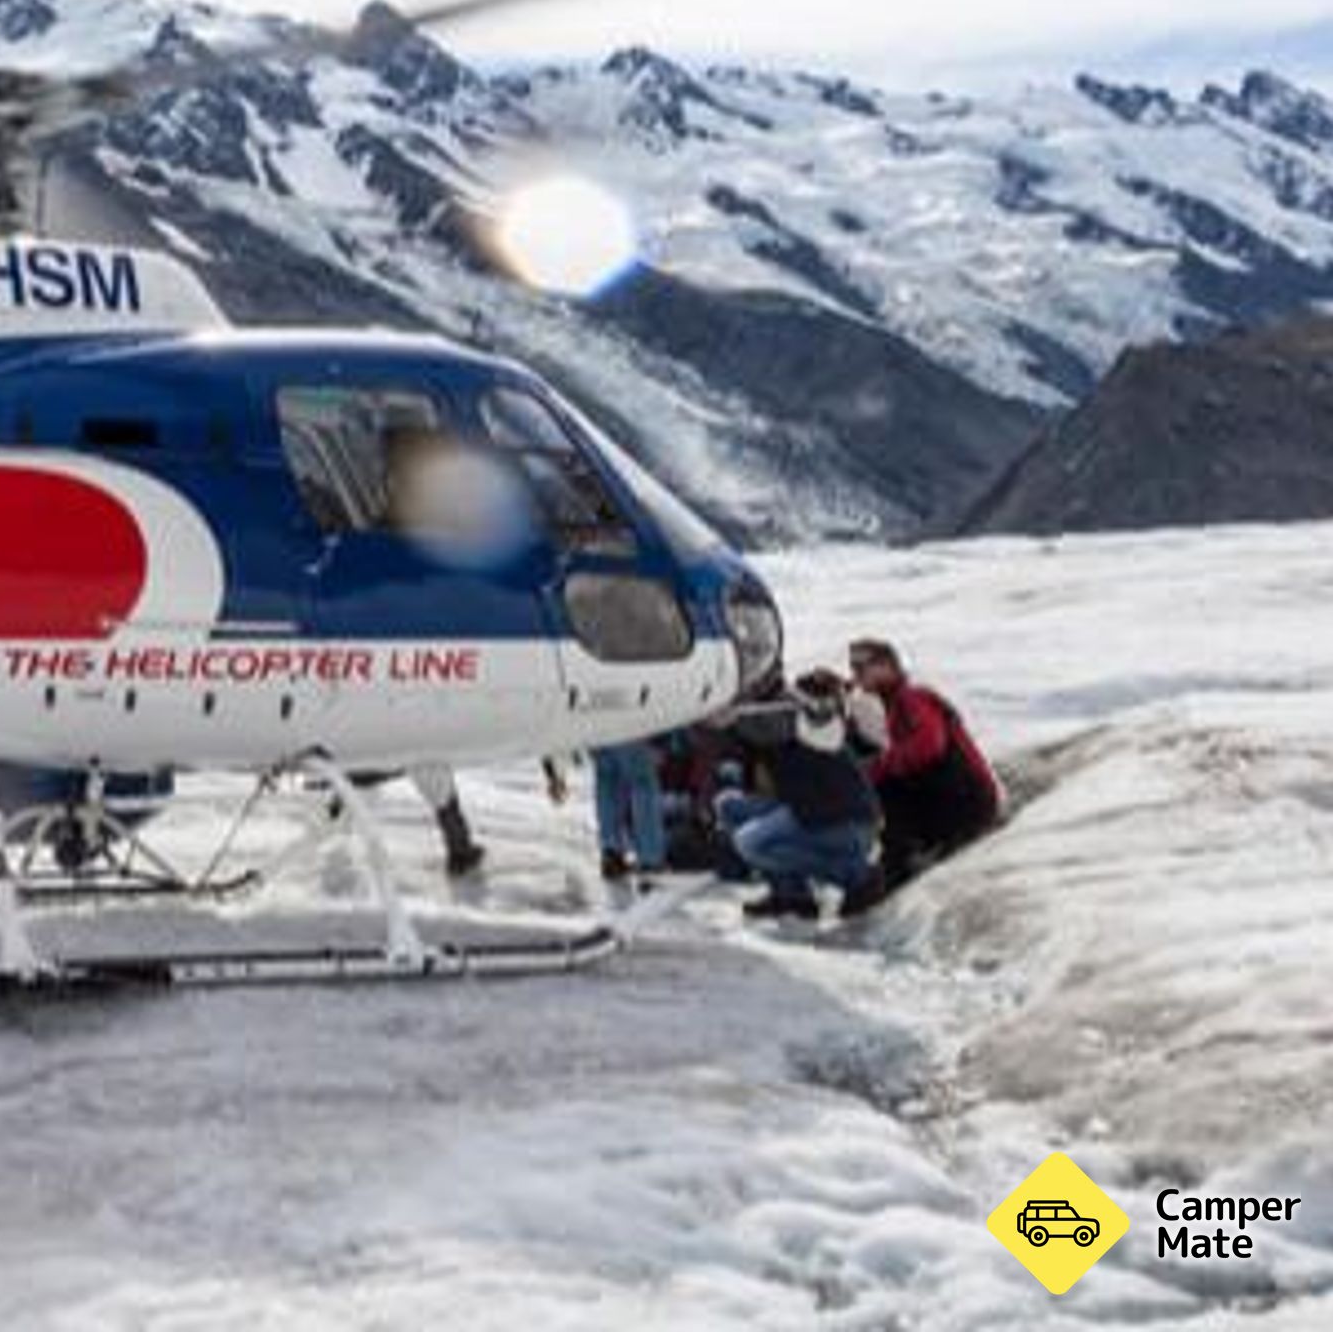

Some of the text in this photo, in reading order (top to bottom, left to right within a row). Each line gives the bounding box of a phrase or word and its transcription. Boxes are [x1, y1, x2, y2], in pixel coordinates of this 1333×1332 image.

[4, 647, 480, 681] THE HELICOPTER LINE
